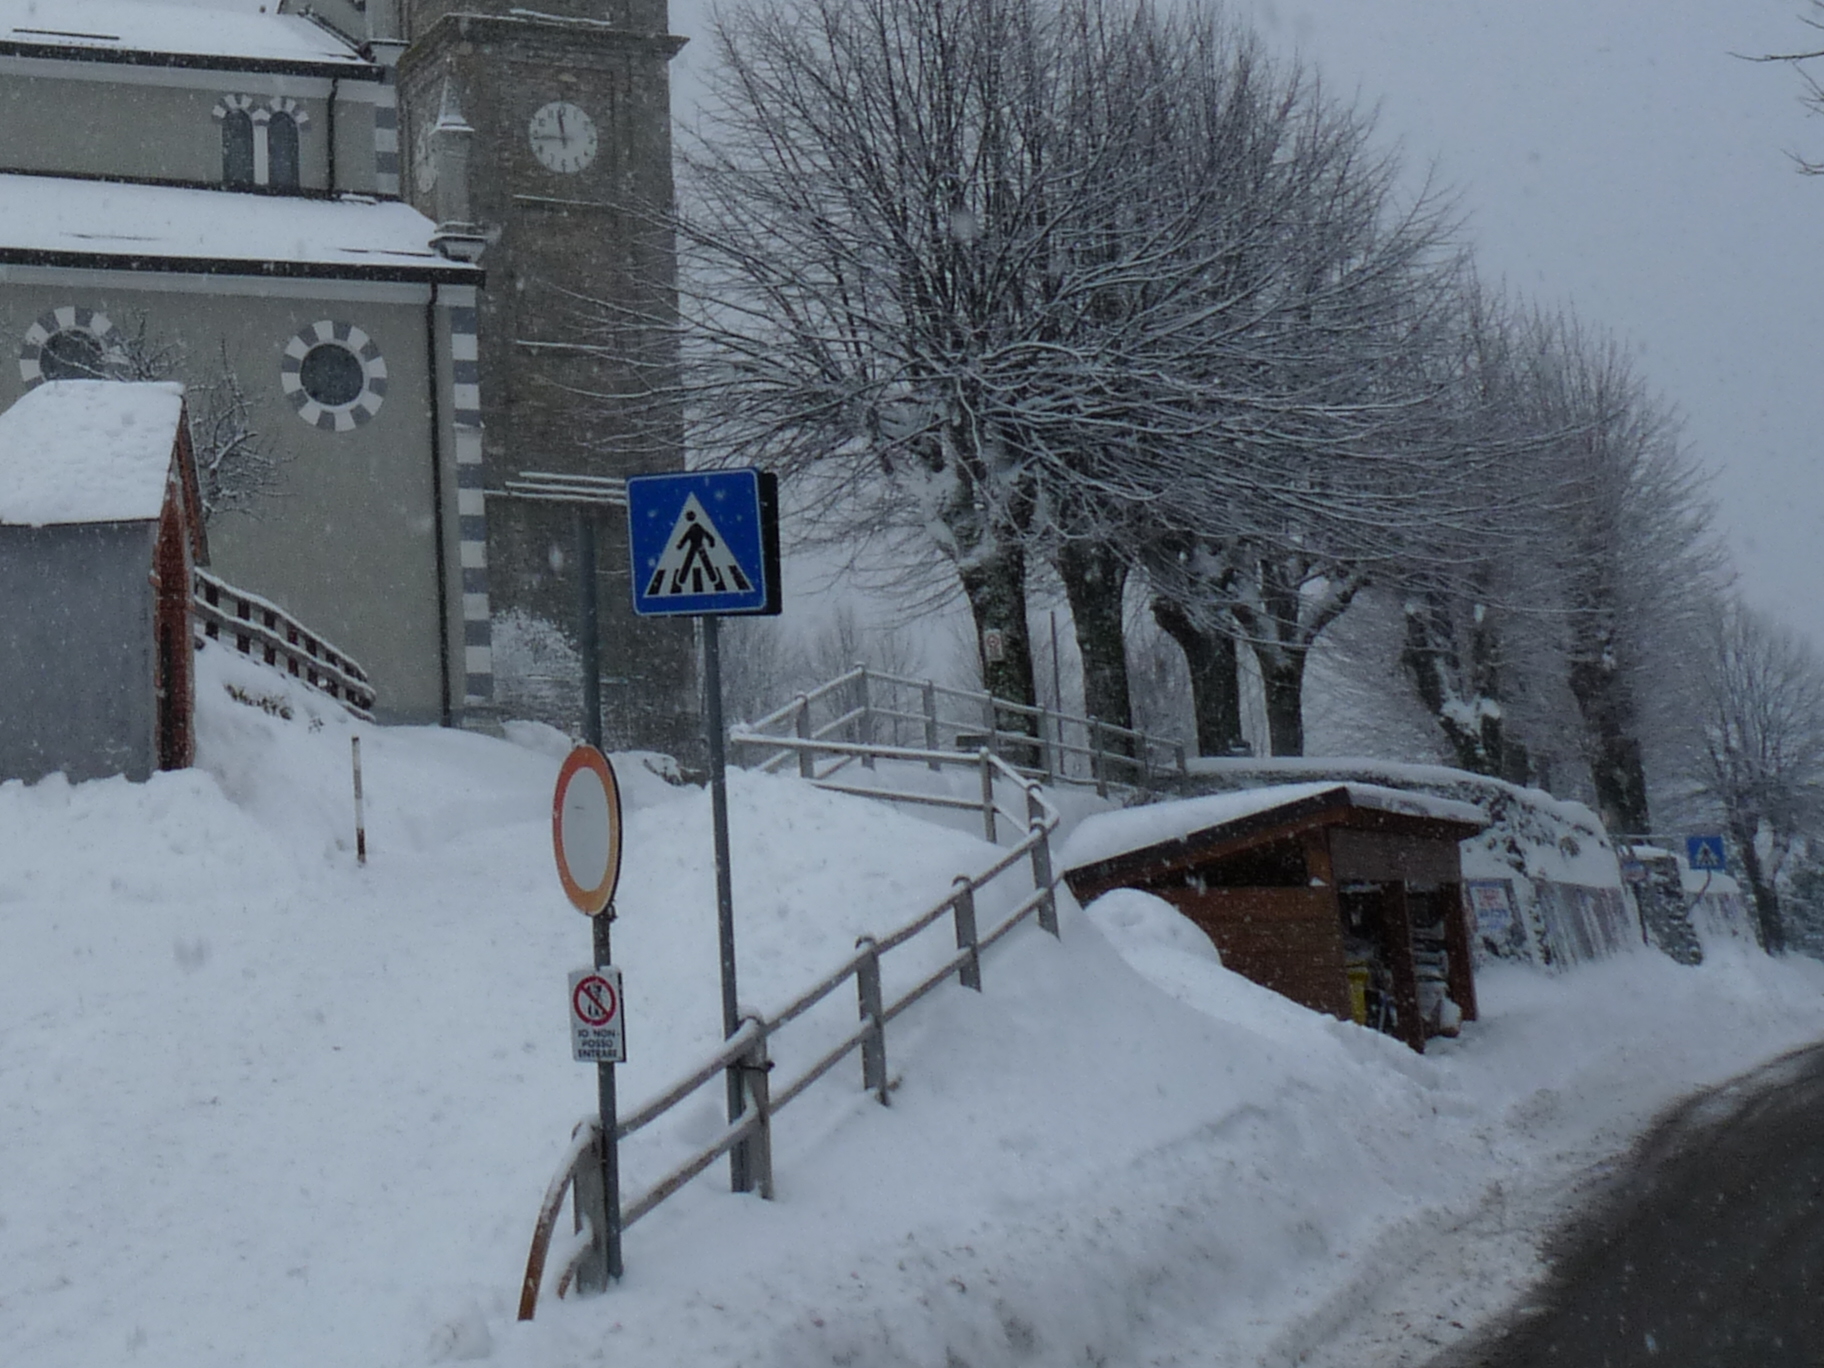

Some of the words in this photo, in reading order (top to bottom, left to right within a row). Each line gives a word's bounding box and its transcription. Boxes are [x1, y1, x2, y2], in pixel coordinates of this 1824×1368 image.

[593, 1028, 616, 1038] NON
[582, 1038, 613, 1048] POSSO
[578, 1048, 617, 1058] ENTRARE
